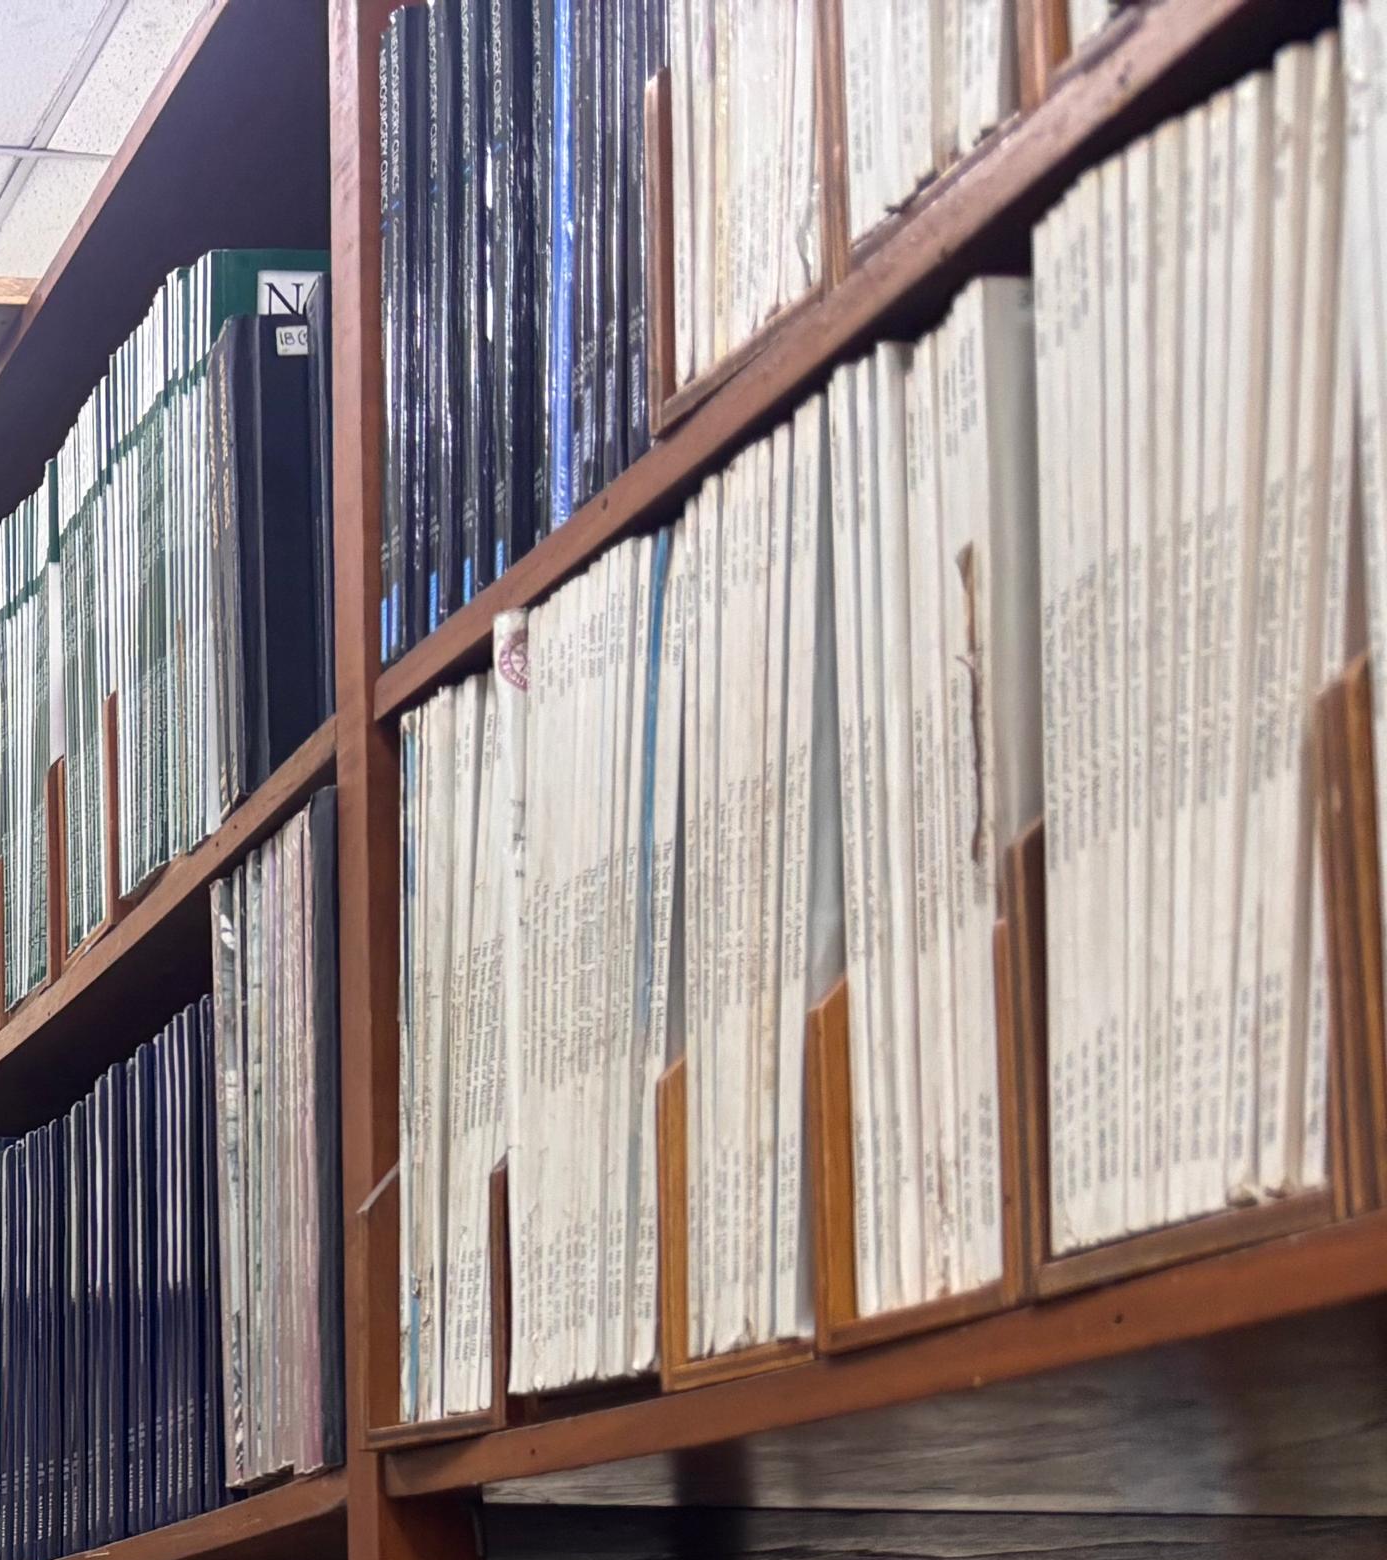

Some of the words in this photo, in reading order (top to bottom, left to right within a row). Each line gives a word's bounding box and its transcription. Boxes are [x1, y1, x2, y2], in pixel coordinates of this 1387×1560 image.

[379, 49, 388, 145] NEUROSURGERY
[389, 30, 400, 135] NEUROSURGERY
[493, 79, 502, 135] CLINICS
[379, 149, 388, 213] CLINICS
[391, 138, 400, 194] CLINICS
[630, 353, 640, 427] SAUNDERS
[663, 841, 672, 861] The
[662, 866, 671, 891] New
[658, 896, 670, 941] England
[656, 947, 667, 986] Journal
[657, 990, 665, 1002] of
[654, 1006, 664, 1057] Medicine
